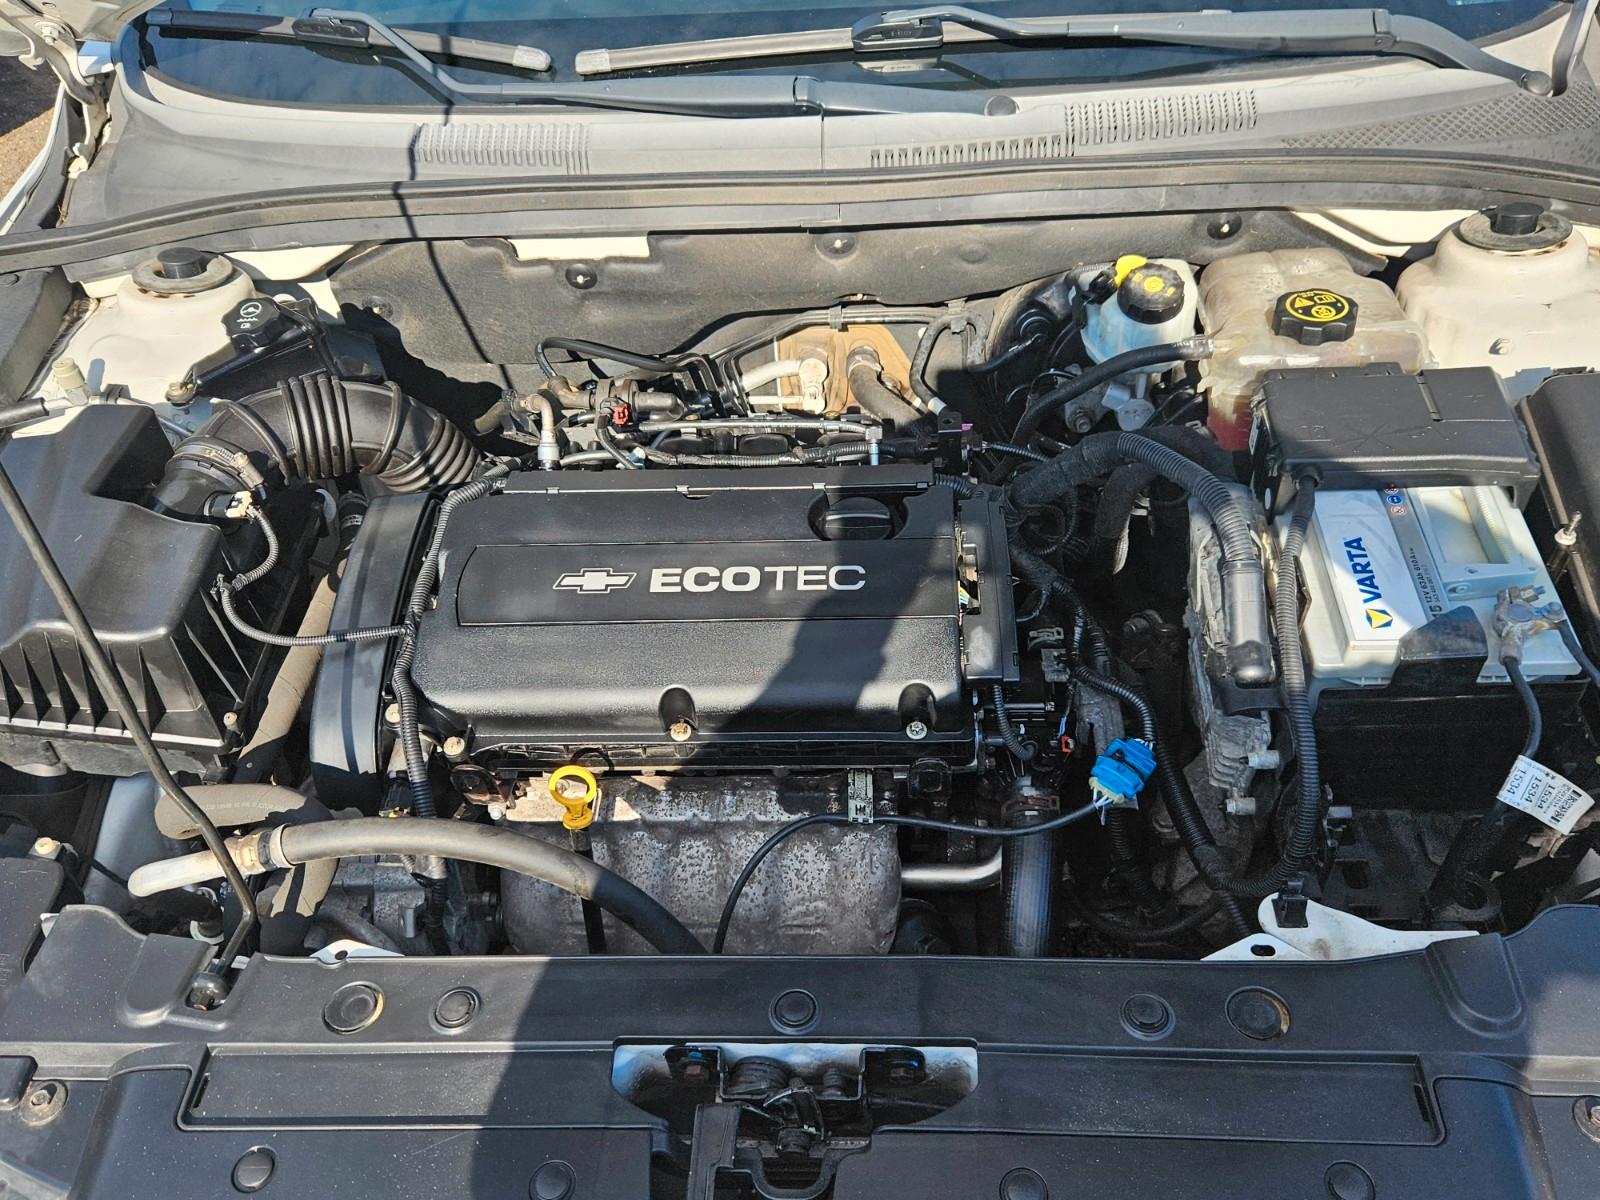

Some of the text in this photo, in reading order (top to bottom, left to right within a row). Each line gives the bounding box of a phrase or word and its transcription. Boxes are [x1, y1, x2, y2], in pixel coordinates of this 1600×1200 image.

[649, 565, 867, 593] ECOTEC
[1343, 536, 1383, 604] VARTA
[1423, 590, 1433, 603] 12V
[1506, 768, 1527, 796] 1534
[1524, 776, 1543, 804] 1534
[1537, 783, 1556, 810] 1534
